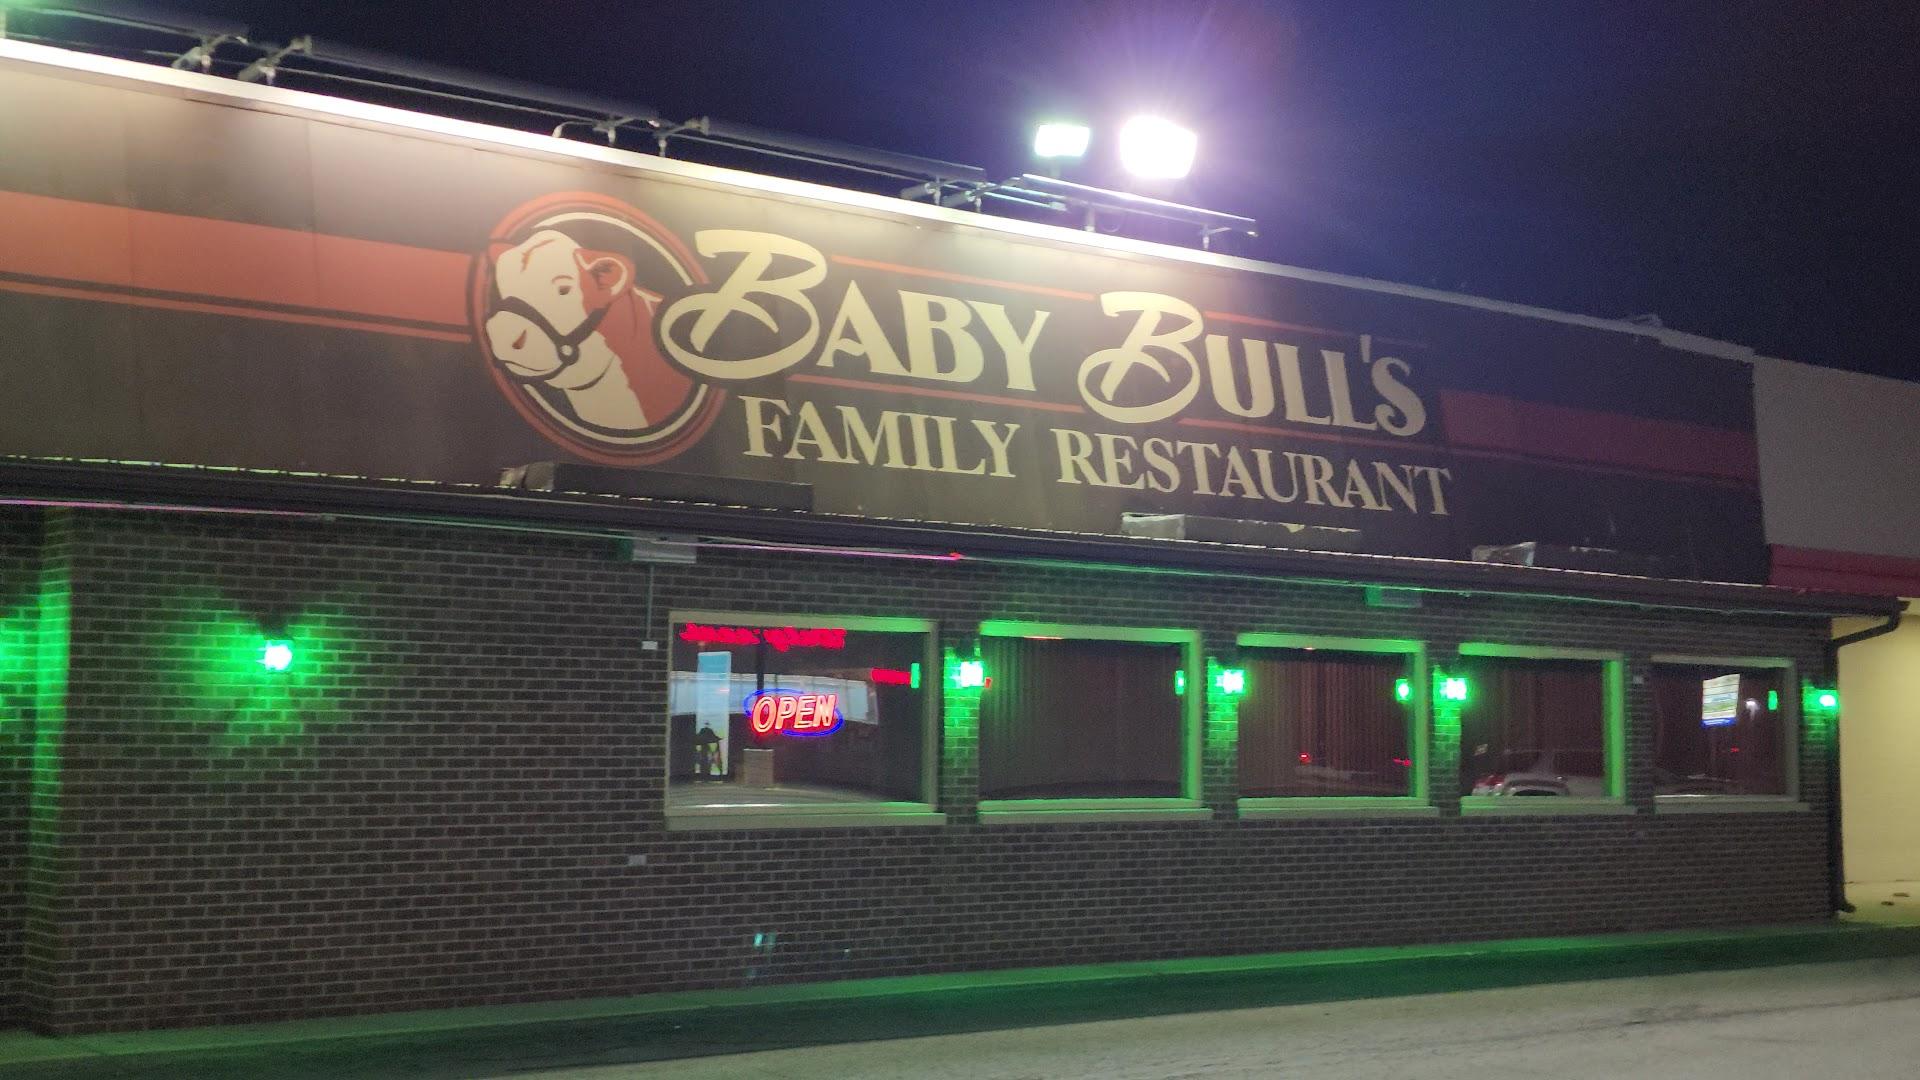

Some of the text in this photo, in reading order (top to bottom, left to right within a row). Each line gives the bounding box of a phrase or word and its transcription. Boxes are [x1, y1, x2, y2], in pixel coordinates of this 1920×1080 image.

[661, 230, 1427, 436] BABY BULL'S
[738, 395, 1451, 515] FAMILY RESTAURANT
[752, 695, 836, 732] OPEN
